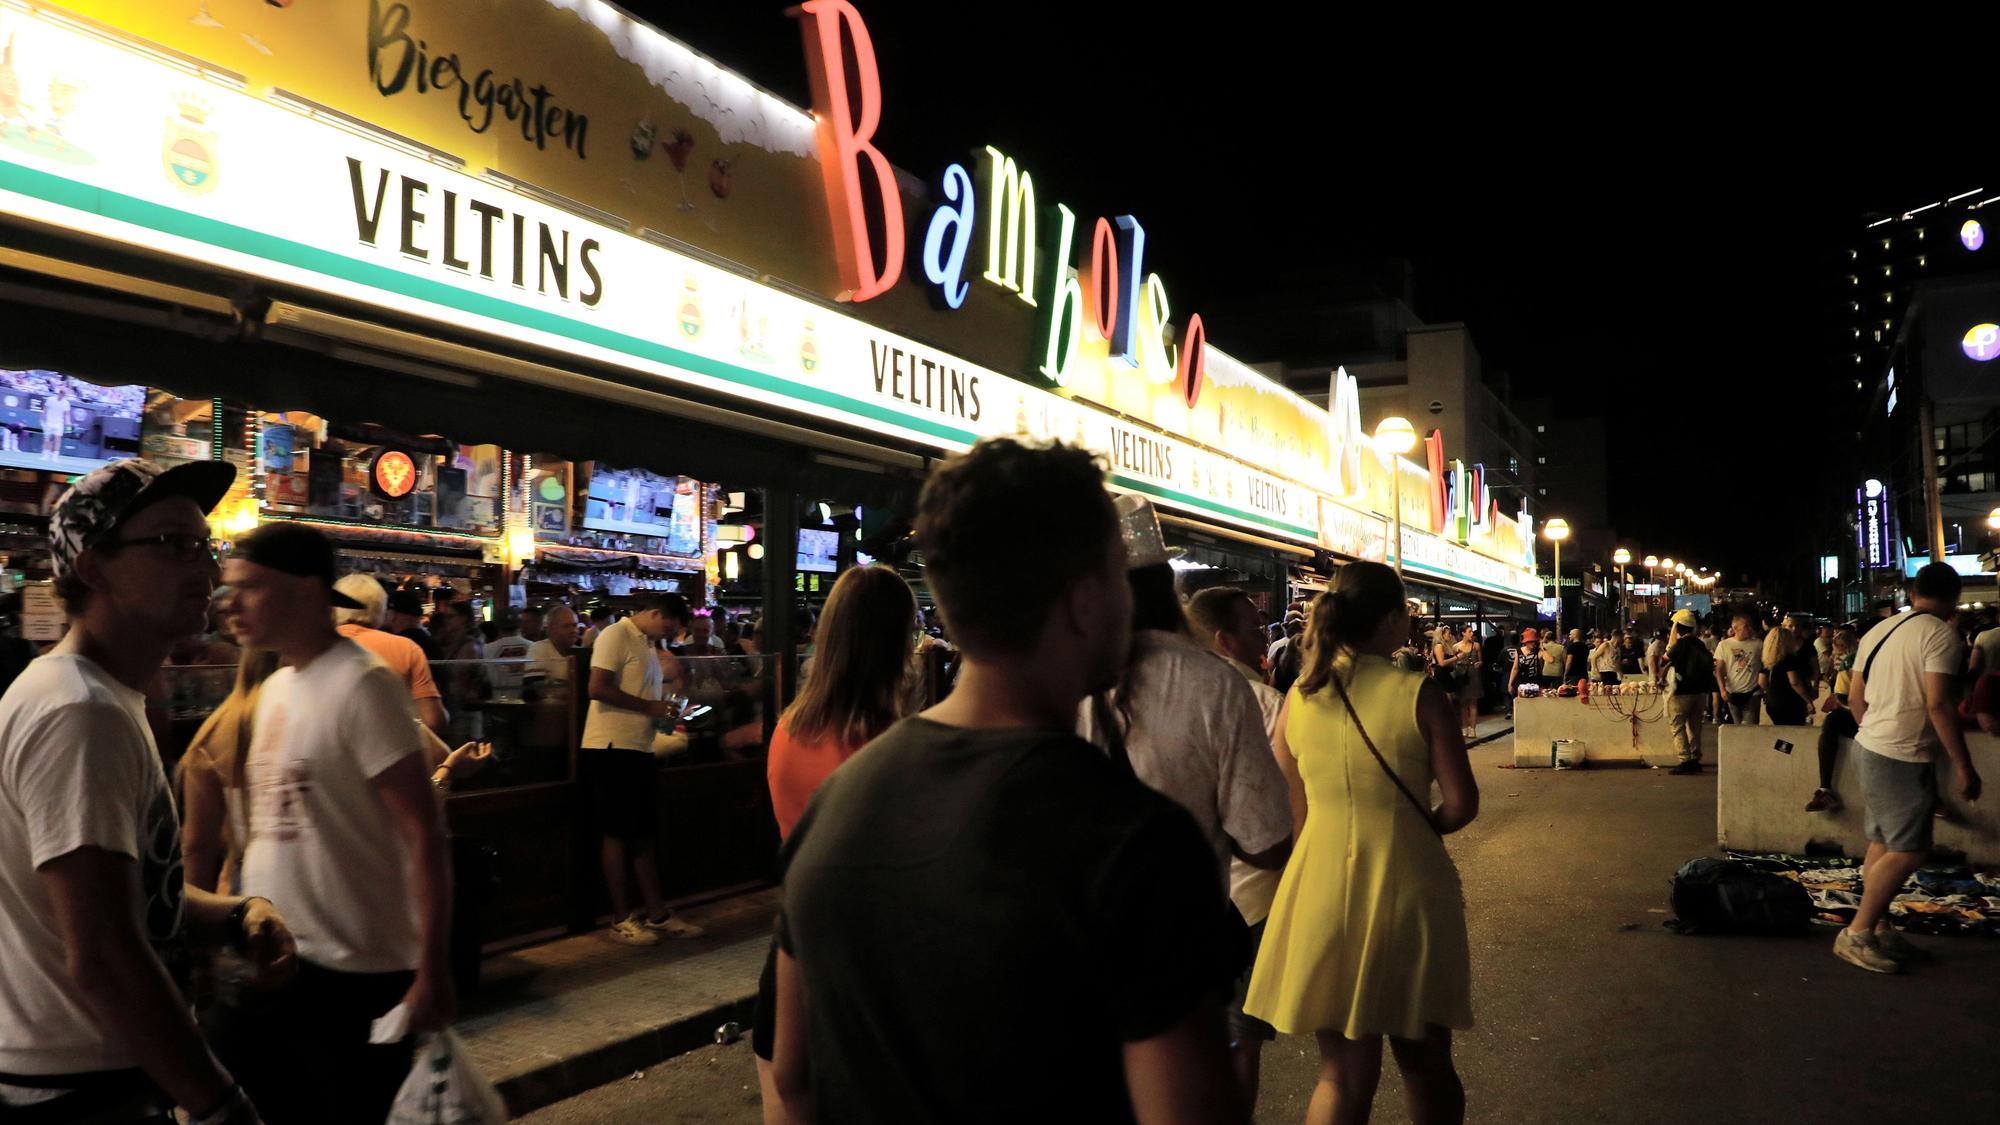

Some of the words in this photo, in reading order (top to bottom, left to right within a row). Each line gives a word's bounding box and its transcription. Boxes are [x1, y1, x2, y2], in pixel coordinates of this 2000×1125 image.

[368, 0, 588, 160] Biergarten
[346, 156, 603, 307] VELTINS
[800, 0, 1206, 408] Bamboleo
[870, 339, 981, 422] VELTINS
[1111, 426, 1171, 480] VELTINS
[1248, 475, 1287, 516] VELTINS
